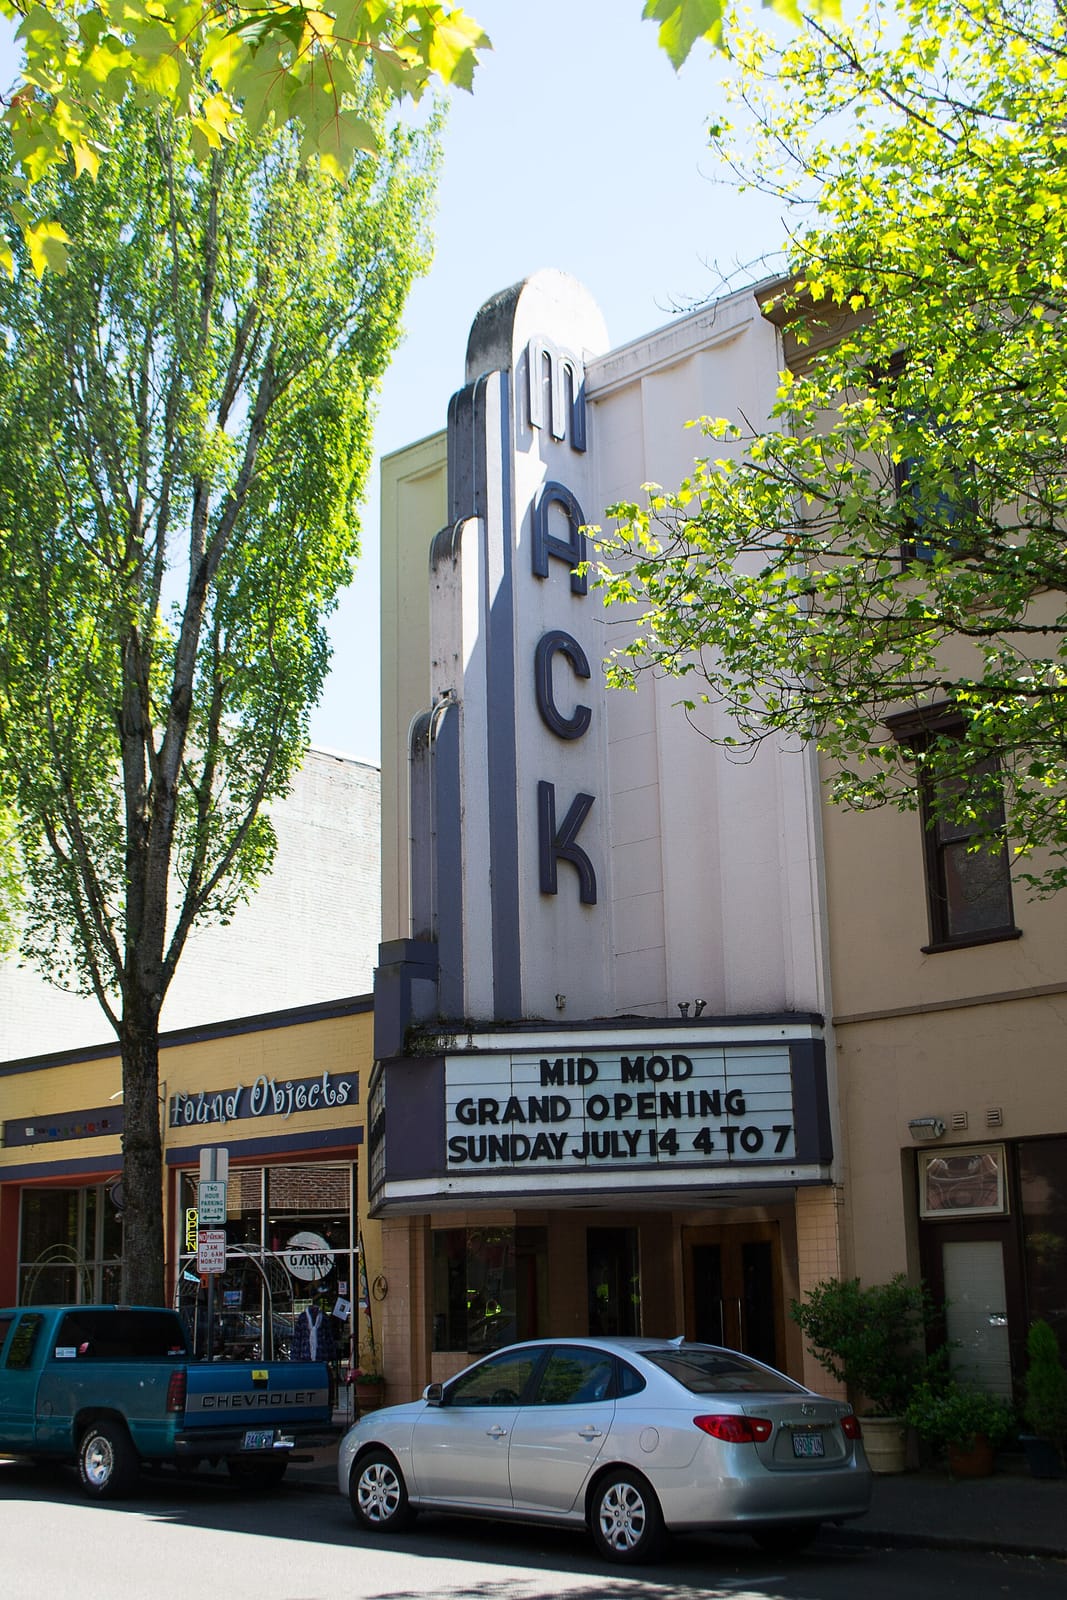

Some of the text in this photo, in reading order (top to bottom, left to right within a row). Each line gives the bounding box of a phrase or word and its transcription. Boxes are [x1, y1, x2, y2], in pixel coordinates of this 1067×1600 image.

[526, 335, 597, 906] MACK
[540, 1054, 694, 1087] MID MOD
[171, 1070, 352, 1125] Found Objects
[455, 1089, 746, 1125] GRAND OPENING
[448, 1132, 568, 1163] SUNDAY
[572, 1129, 642, 1160] JULY
[692, 1127, 715, 1155] 4
[720, 1125, 764, 1154] TO
[772, 1125, 792, 1153] 7
[187, 1209, 197, 1251] OPEN
[202, 1392, 316, 1409] CHEVROLET
